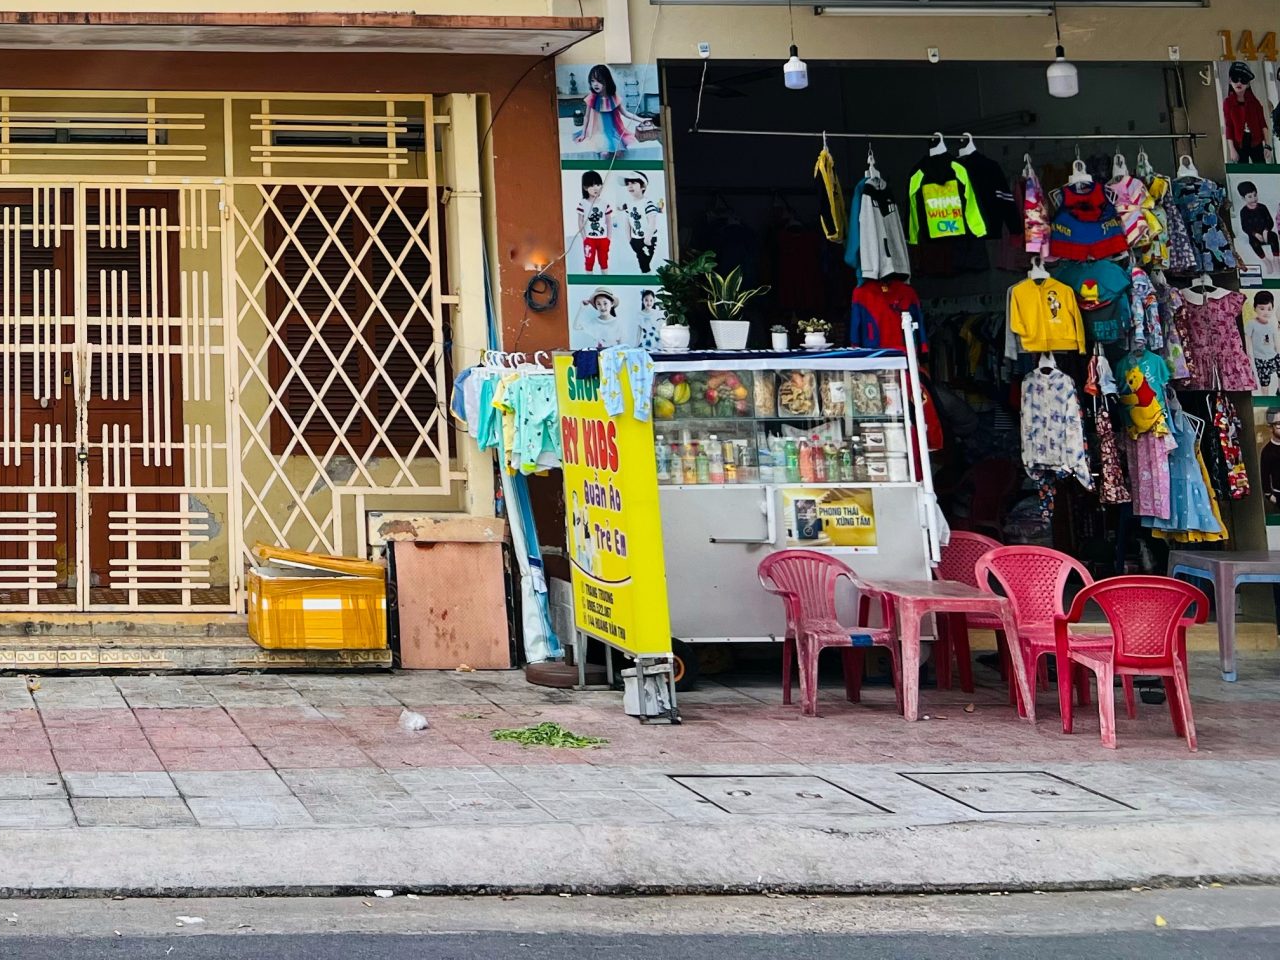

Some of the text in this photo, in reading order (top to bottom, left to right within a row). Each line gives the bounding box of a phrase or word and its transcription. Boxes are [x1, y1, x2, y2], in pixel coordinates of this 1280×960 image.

[1218, 30, 1279, 62] 144
[937, 220, 960, 233] OK
[567, 366, 600, 402] SHOP
[562, 415, 619, 473] RY KIDS
[818, 506, 859, 516] PHONG THÁI
